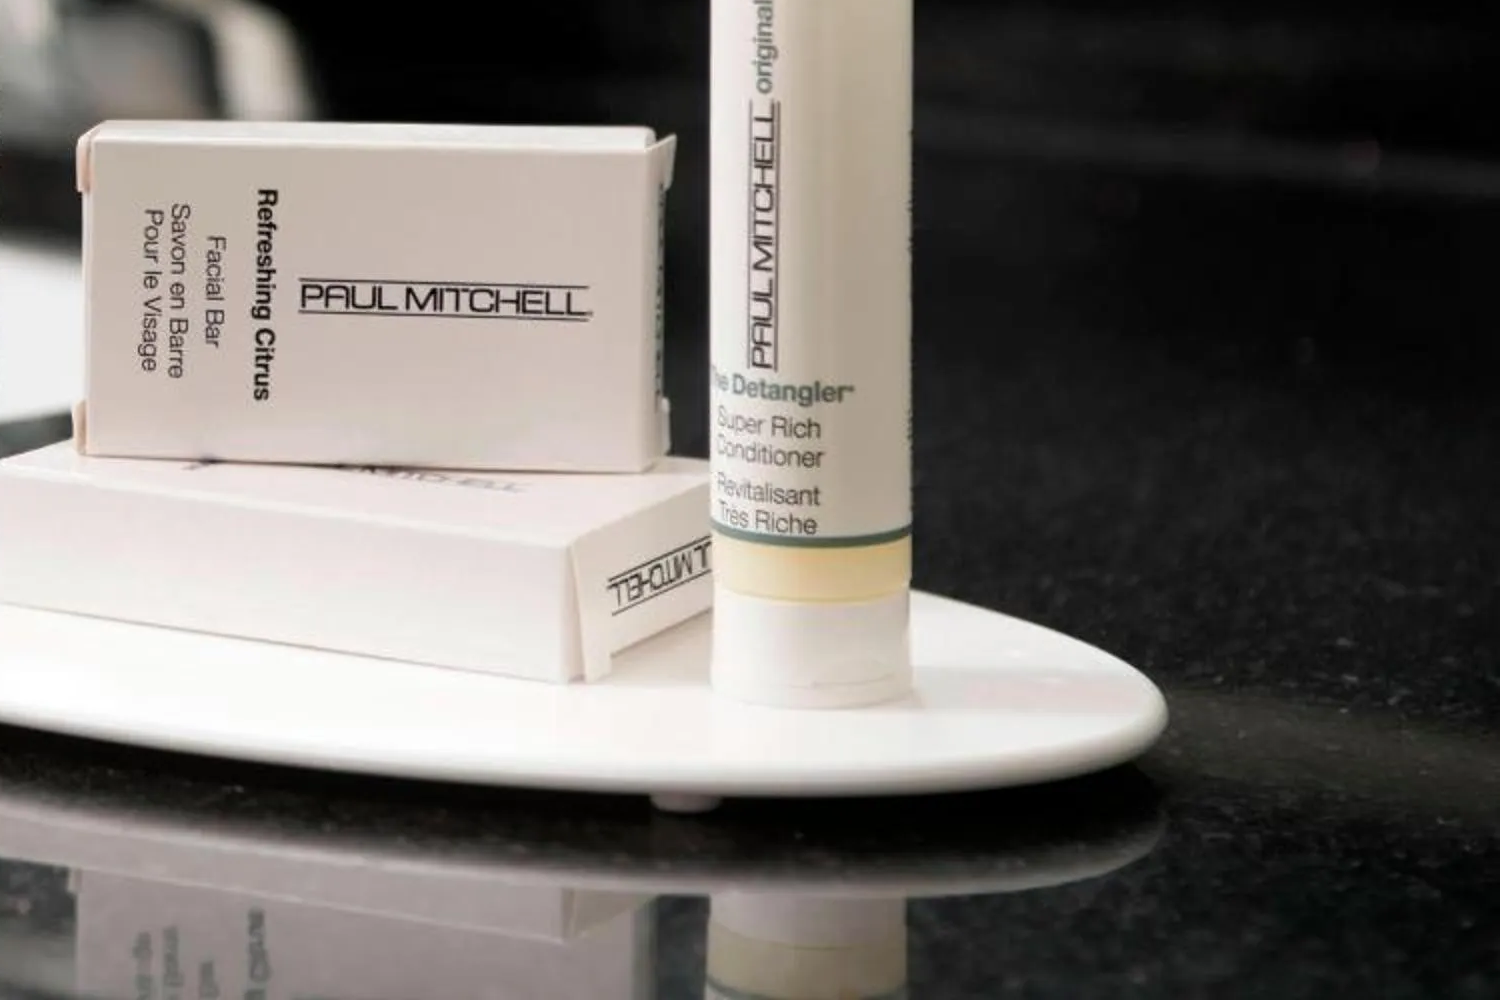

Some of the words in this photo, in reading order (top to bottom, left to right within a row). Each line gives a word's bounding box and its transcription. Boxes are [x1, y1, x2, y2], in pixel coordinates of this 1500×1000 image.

[752, 100, 775, 272] MITCHELL
[144, 209, 164, 267] Pour
[169, 203, 191, 275] Savon
[252, 188, 279, 320] Refreshing
[142, 272, 162, 290] le
[169, 280, 185, 303] en
[206, 235, 227, 306] Facial
[204, 310, 225, 348] Bar
[300, 283, 399, 312] PAUL
[405, 285, 588, 317] MITCHELL
[751, 277, 774, 371] PAUL
[137, 293, 162, 373] Visage
[167, 307, 189, 379] Barre
[254, 328, 277, 401] Citrus
[717, 404, 765, 434] Super
[771, 415, 822, 439] Rich
[717, 433, 826, 468] Conditioner
[717, 471, 821, 506] Revitalisant
[755, 509, 818, 535] Riche
